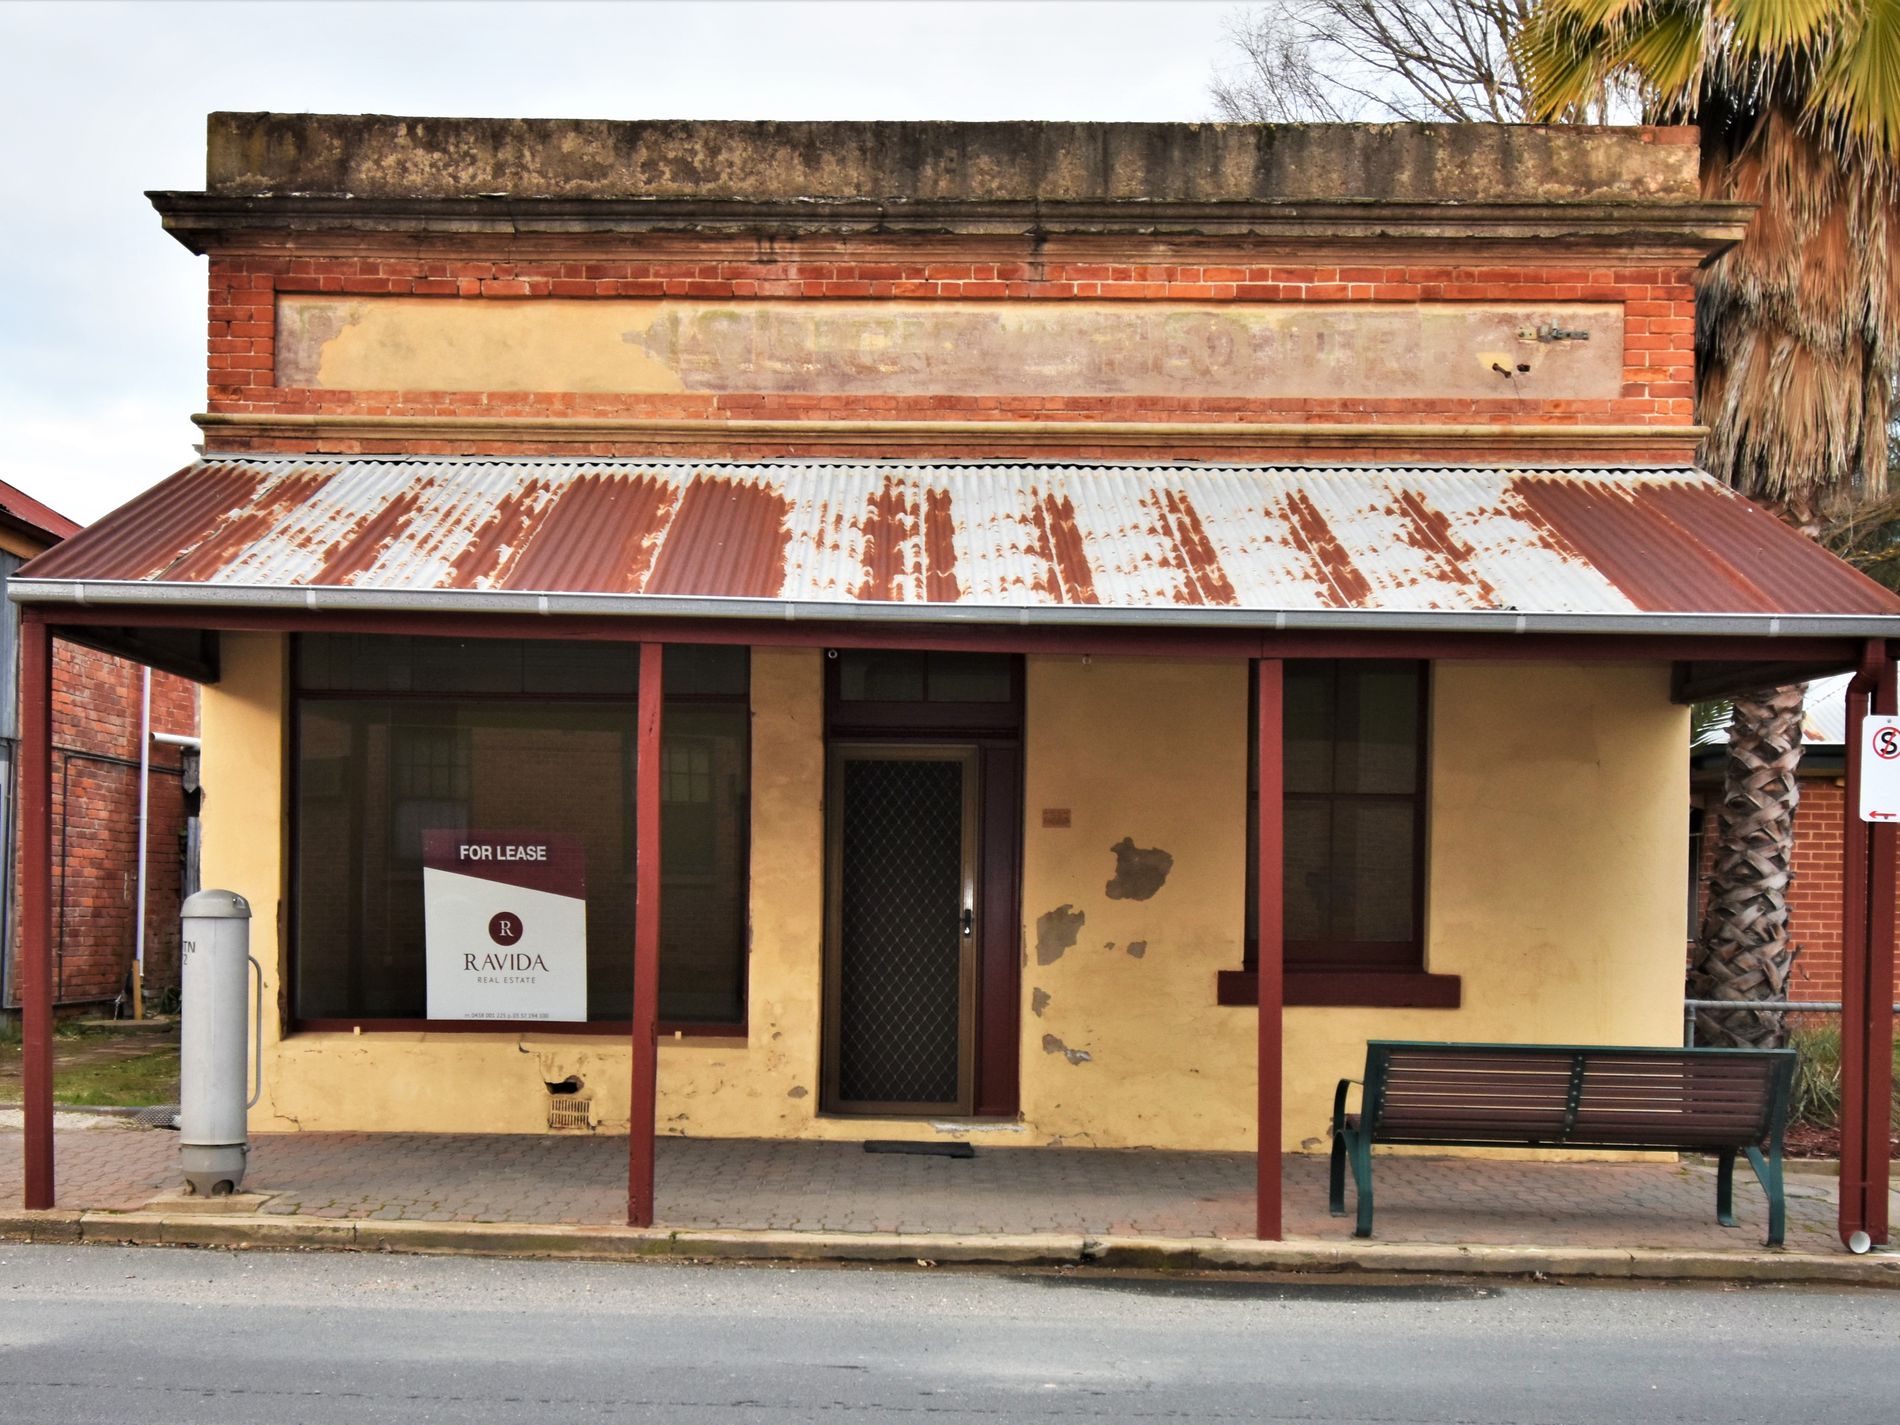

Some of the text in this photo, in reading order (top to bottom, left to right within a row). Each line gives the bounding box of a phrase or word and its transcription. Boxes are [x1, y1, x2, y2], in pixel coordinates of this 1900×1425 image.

[460, 845, 547, 860] FOR LEASE
[499, 920, 514, 937] R
[464, 953, 550, 972] RAVIDA
[477, 976, 536, 984] REAL ESTATE
